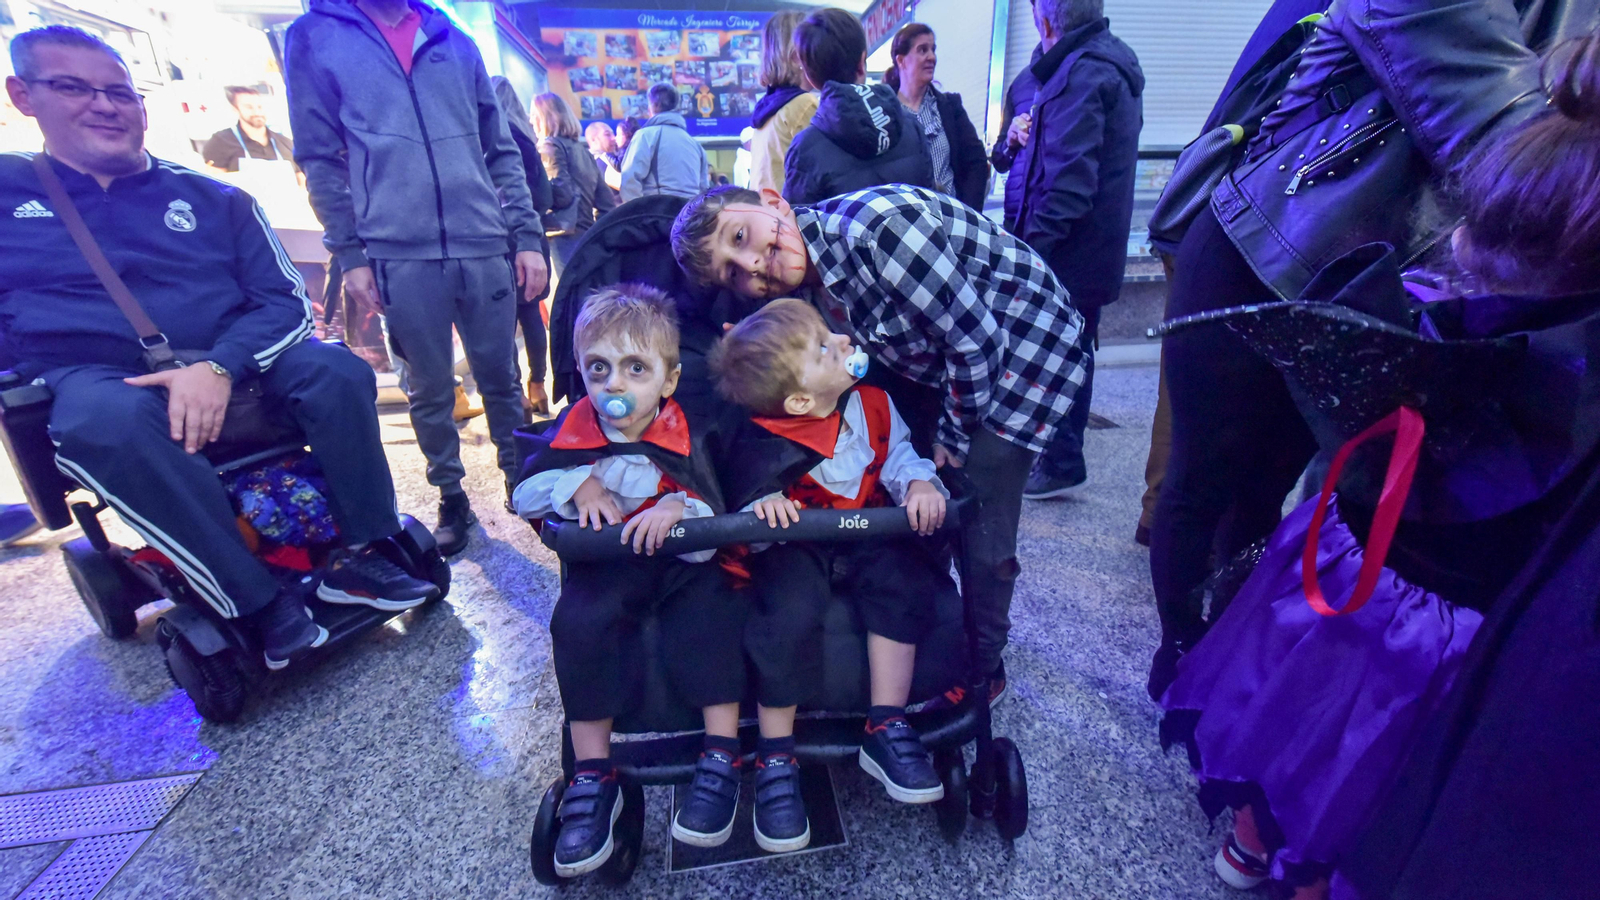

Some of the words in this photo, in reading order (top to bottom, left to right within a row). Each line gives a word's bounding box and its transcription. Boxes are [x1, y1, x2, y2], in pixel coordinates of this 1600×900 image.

[637, 13, 678, 26] Mercado
[681, 14, 723, 29] Ingeniero
[12, 209, 54, 218] adidas
[838, 514, 869, 529] Joie
